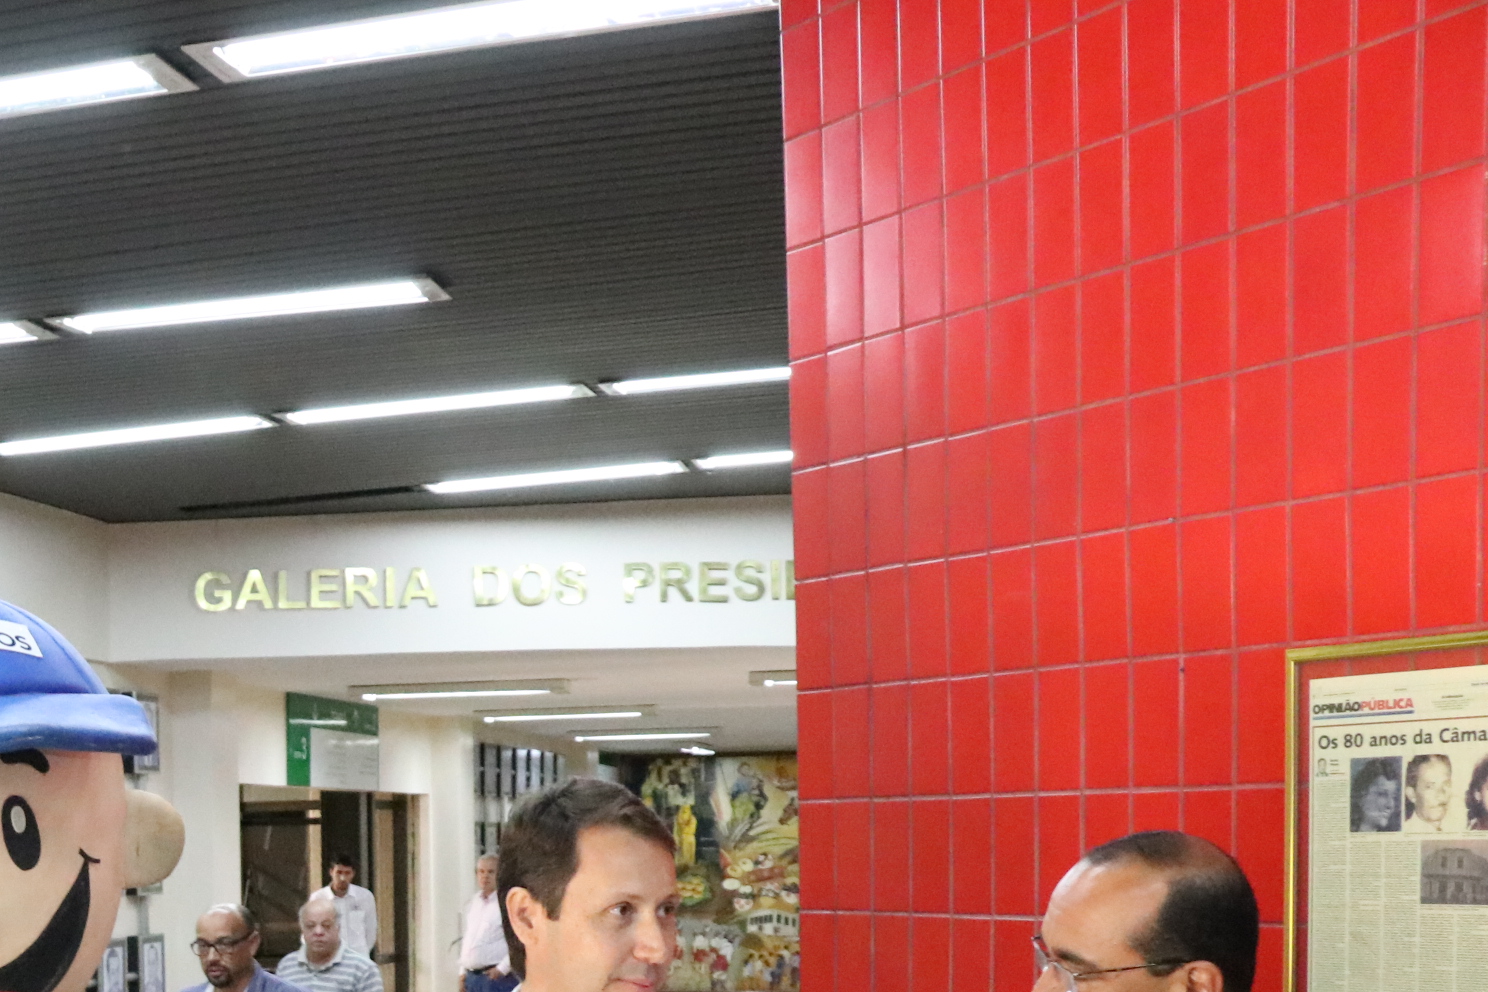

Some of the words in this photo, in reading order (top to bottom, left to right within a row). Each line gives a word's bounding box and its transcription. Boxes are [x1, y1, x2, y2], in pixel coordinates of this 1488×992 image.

[194, 566, 438, 612] GALERIA
[473, 561, 588, 607] DOS
[623, 559, 796, 605] PRESI
[1318, 735, 1338, 750] Os
[1344, 733, 1363, 748] 80
[1369, 735, 1407, 747] anos
[1413, 729, 1432, 744] da
[1439, 727, 1488, 744] Câma
